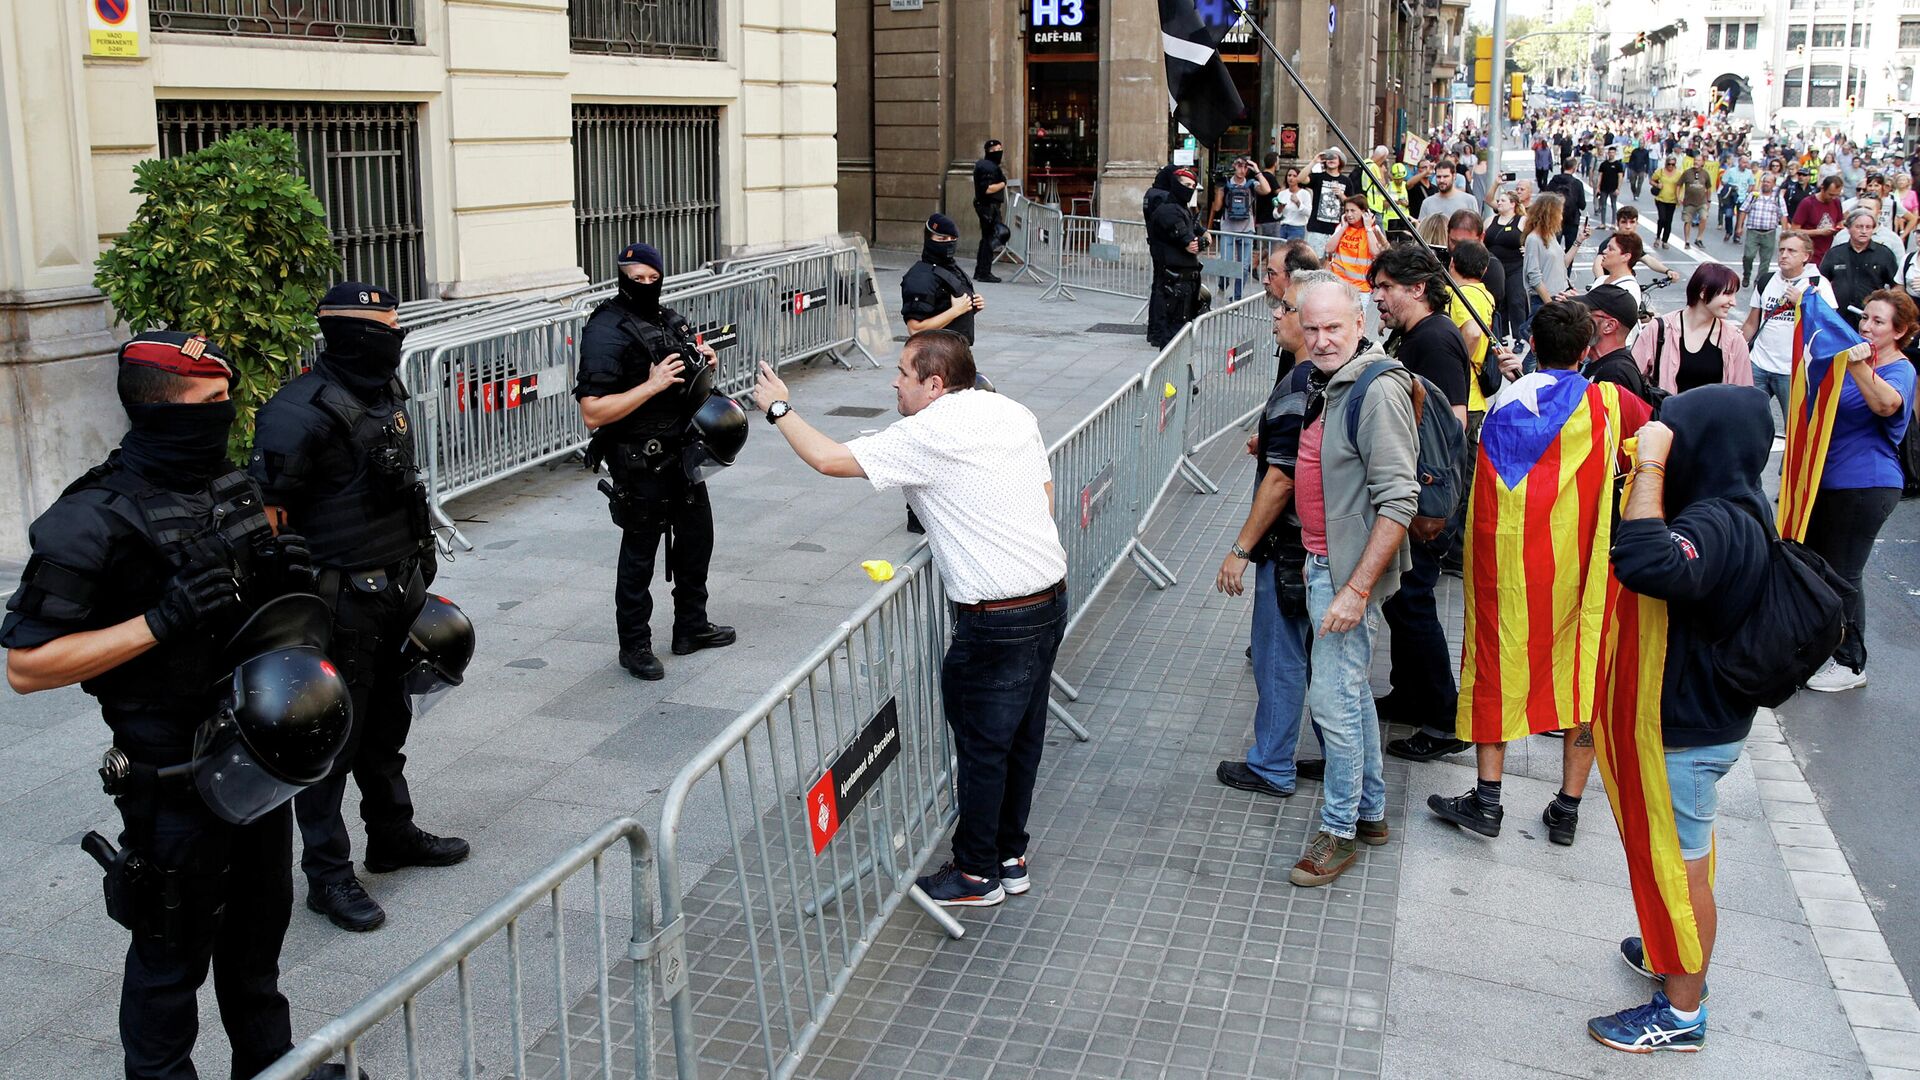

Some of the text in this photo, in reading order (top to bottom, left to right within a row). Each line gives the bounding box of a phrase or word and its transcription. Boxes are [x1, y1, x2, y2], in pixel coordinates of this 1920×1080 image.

[1032, 0, 1083, 26] H3
[840, 727, 896, 798] Ajuntament de Barcelona
